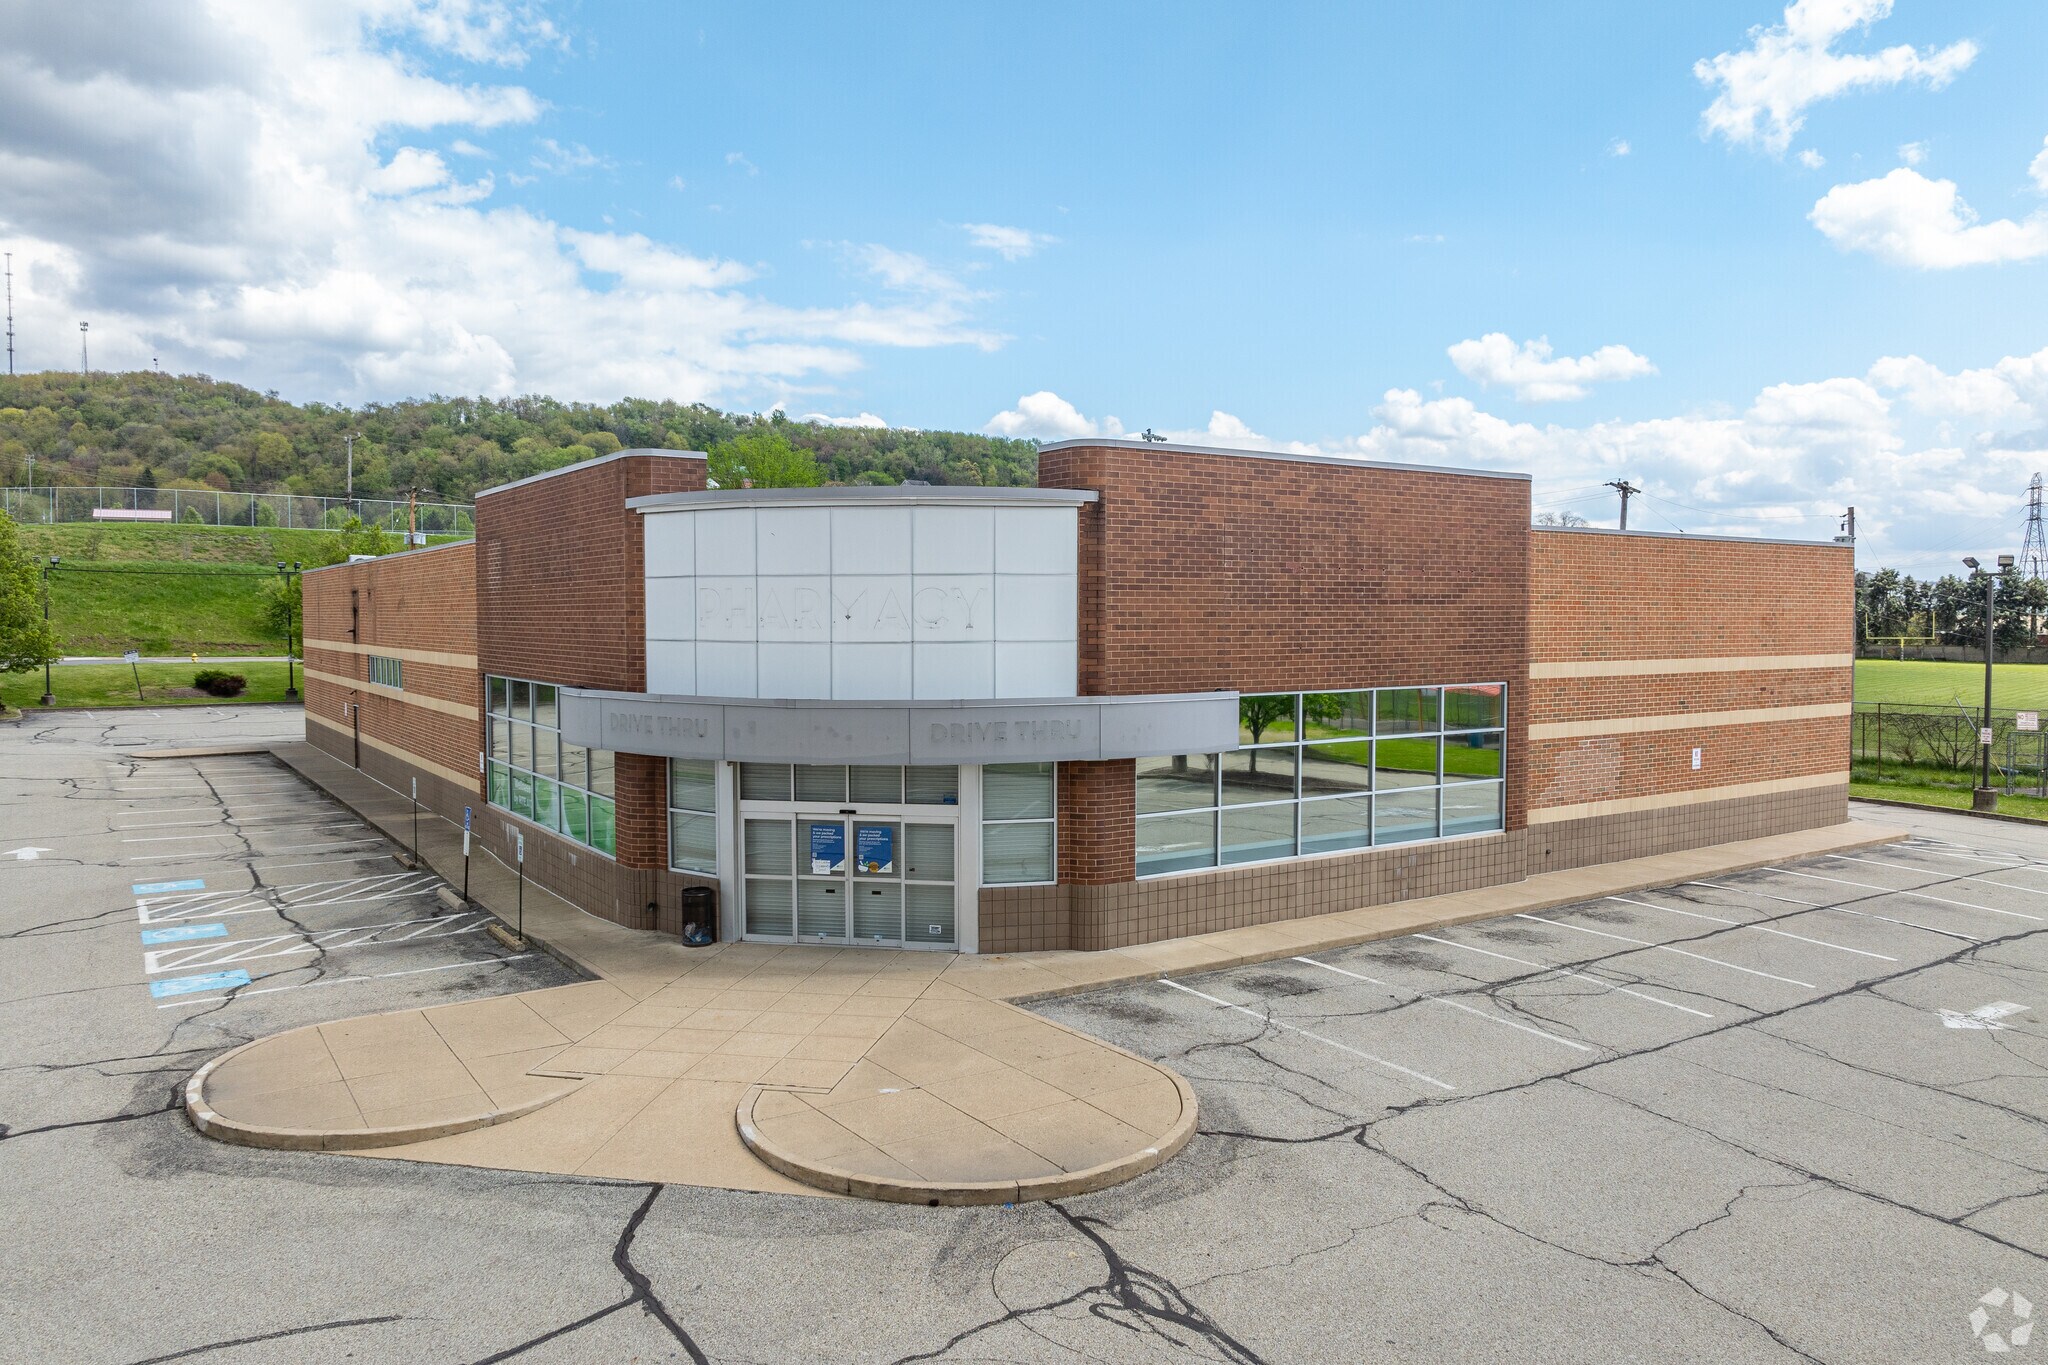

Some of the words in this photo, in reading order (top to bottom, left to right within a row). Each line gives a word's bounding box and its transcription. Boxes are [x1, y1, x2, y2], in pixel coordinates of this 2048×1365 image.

[699, 586, 989, 631] PHARMACY
[610, 711, 654, 736] DRIVE
[657, 716, 709, 739] THRU
[930, 720, 1009, 745] DRIVE
[1014, 718, 1083, 742] THRU
